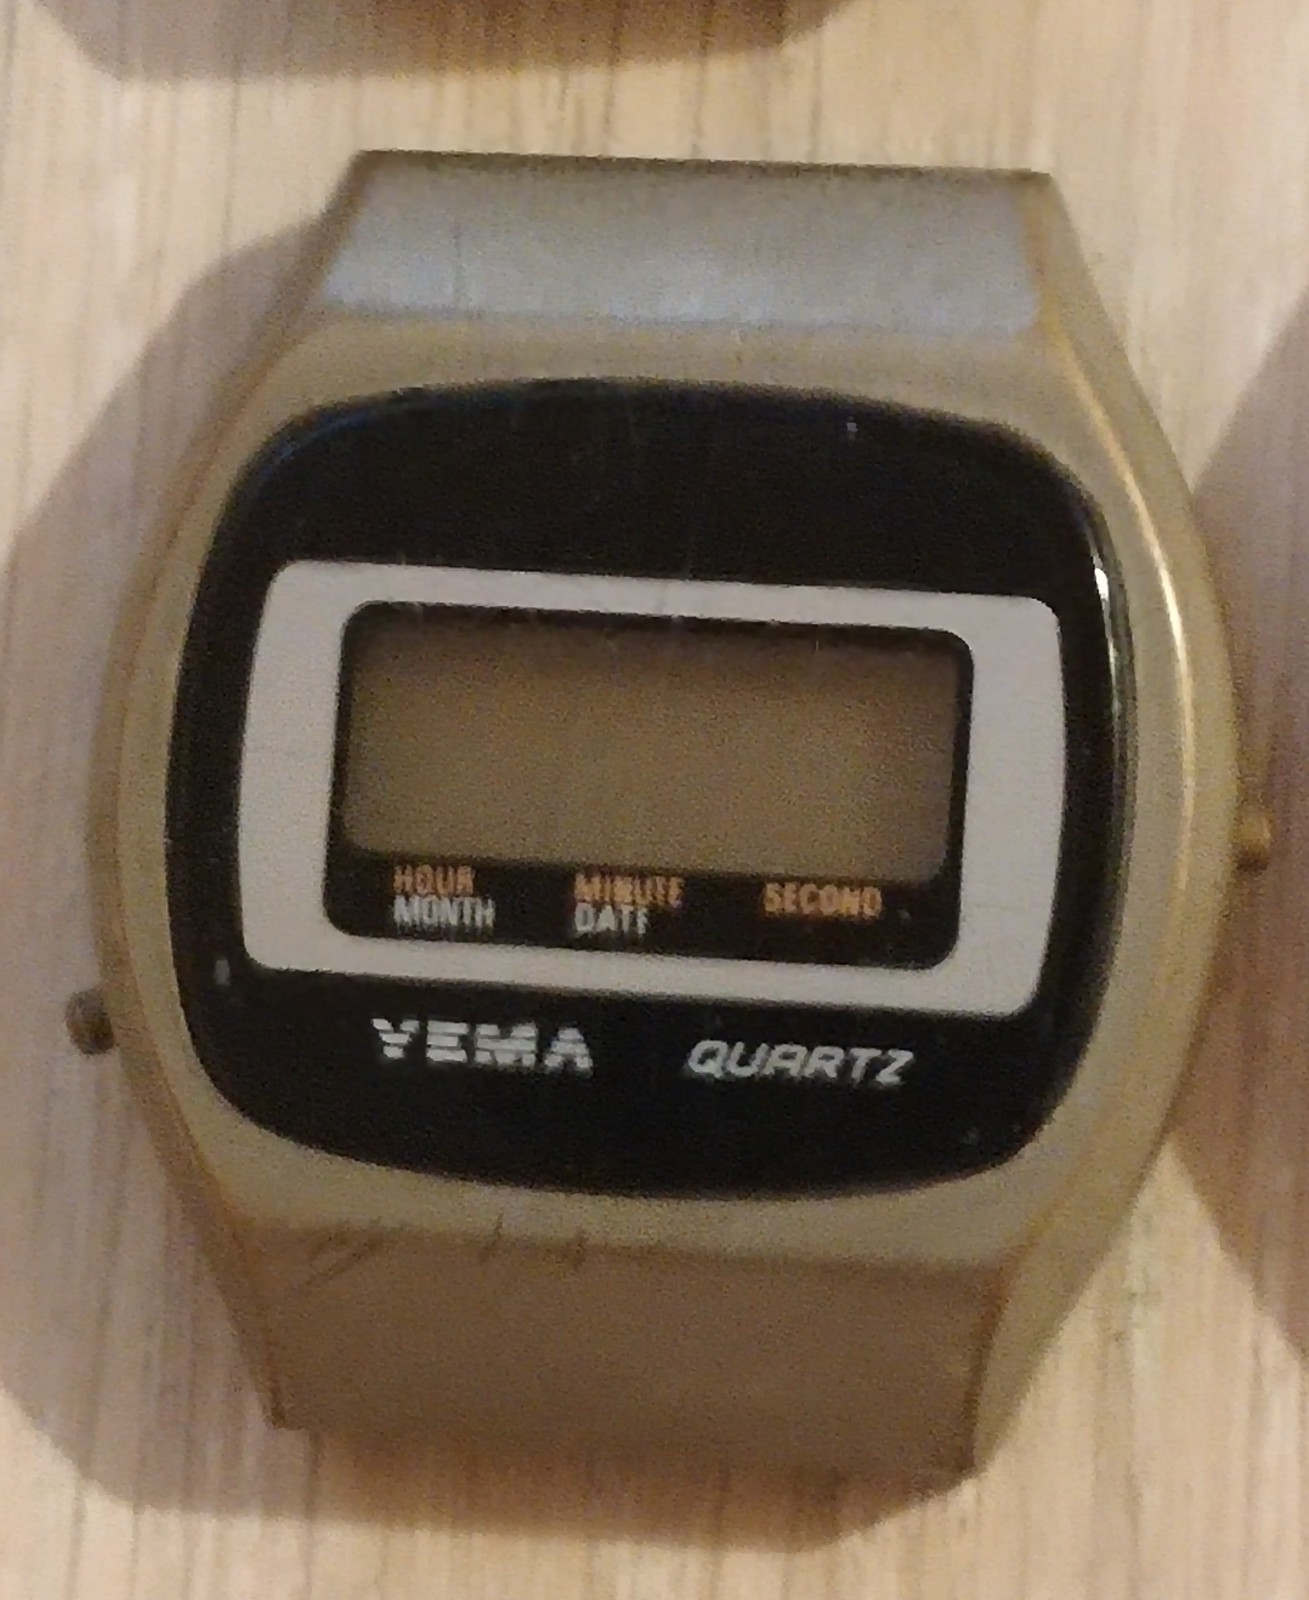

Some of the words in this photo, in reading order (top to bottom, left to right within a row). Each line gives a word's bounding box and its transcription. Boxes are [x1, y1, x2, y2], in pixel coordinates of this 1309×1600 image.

[393, 865, 475, 895] HOUR
[573, 872, 684, 907] MINUTE
[763, 882, 883, 919] SECOND
[393, 895, 496, 930] MONTH
[574, 903, 649, 935] DATE
[371, 1018, 594, 1075] YEMA
[687, 1039, 914, 1086] QUARTZ
